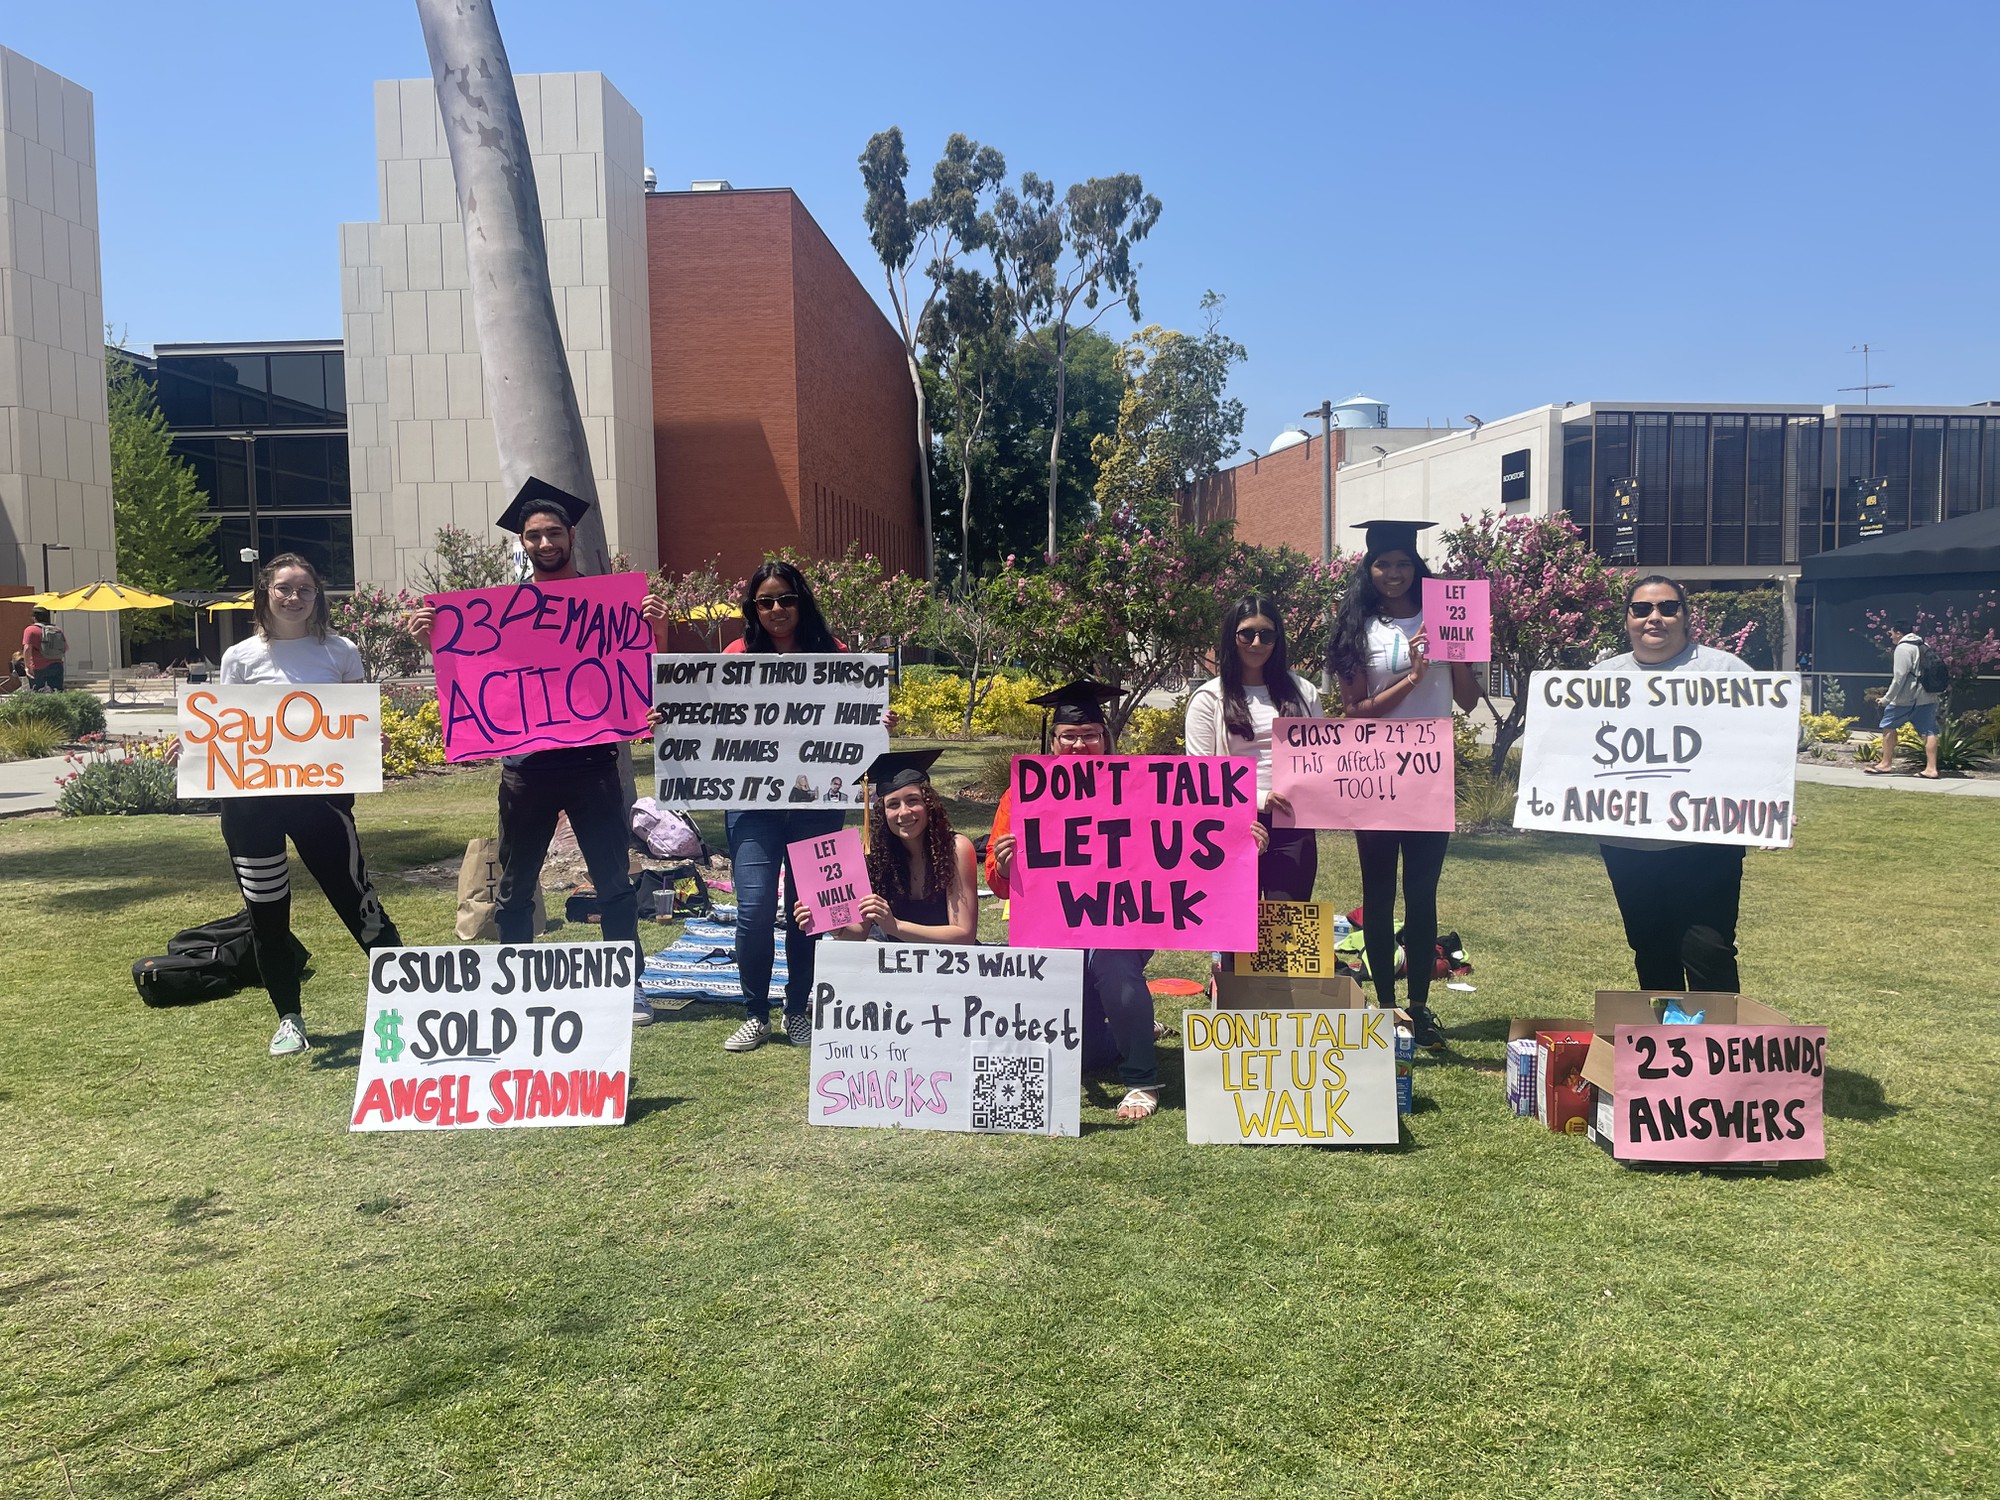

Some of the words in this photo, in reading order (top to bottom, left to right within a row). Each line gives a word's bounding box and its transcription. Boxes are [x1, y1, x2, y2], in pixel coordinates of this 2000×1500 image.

[1503, 470, 1525, 483] BOOKSTORE
[1445, 585, 1466, 600] LET
[1446, 605, 1466, 621] '23
[500, 584, 653, 658] DEMANDS
[1439, 625, 1474, 641] WALK
[656, 661, 717, 685] WON'T
[722, 661, 756, 685] SIT
[759, 661, 807, 685] THRU
[863, 665, 889, 688] OF
[1544, 676, 1632, 710] CSULB
[1647, 675, 1792, 709] STUDENTS
[446, 652, 654, 747] ACTION
[656, 702, 749, 725] SPEECHES
[754, 702, 780, 725] TO
[783, 702, 825, 725] NOT
[834, 702, 883, 726] HAVE
[185, 691, 273, 755] Say
[276, 691, 369, 742] Our
[1354, 723, 1377, 744] OF
[207, 740, 344, 791] Names
[658, 738, 701, 761] OUR
[712, 738, 779, 763] NAMES
[799, 740, 864, 765] CALLED
[1288, 751, 1325, 774] This
[1337, 748, 1386, 773] affects
[1396, 751, 1441, 776] YOU
[659, 776, 735, 801] UNLESS
[739, 776, 785, 802] IT'S
[1018, 759, 1130, 806] DON'T
[1148, 761, 1249, 808] TALK
[1527, 787, 1554, 817] to
[1562, 785, 1652, 826] ANGEL
[1666, 790, 1790, 840] STADIUM
[814, 839, 837, 860] LET
[1024, 816, 1131, 869] LET
[1151, 819, 1225, 871] US
[819, 862, 843, 882] '23
[816, 883, 857, 908] WALK
[1057, 880, 1208, 930] WALK
[371, 948, 481, 994] CSULB
[491, 946, 634, 995] STUDENTS
[878, 947, 930, 974] LET
[935, 948, 970, 975] '23
[977, 952, 1047, 981] WALK
[410, 1007, 518, 1060] SOLD
[525, 1006, 583, 1057] TO
[815, 982, 913, 1035] Picnic
[963, 995, 1080, 1050] Protest
[1187, 1011, 1282, 1051] DON'T
[1287, 1013, 1389, 1050] TALK
[819, 1040, 853, 1061] Join
[860, 1044, 877, 1060] us
[887, 1042, 911, 1062] for
[1222, 1050, 1282, 1091] LET
[1291, 1049, 1347, 1091] US
[1627, 1035, 1694, 1080] '23
[1705, 1035, 1826, 1077] DEMANDS
[351, 1074, 480, 1126] ANGEL
[487, 1068, 627, 1125] STADIUM
[816, 1067, 952, 1117] SNACKS
[1233, 1089, 1354, 1138] WALK
[1629, 1095, 1805, 1143] ANSWERS
